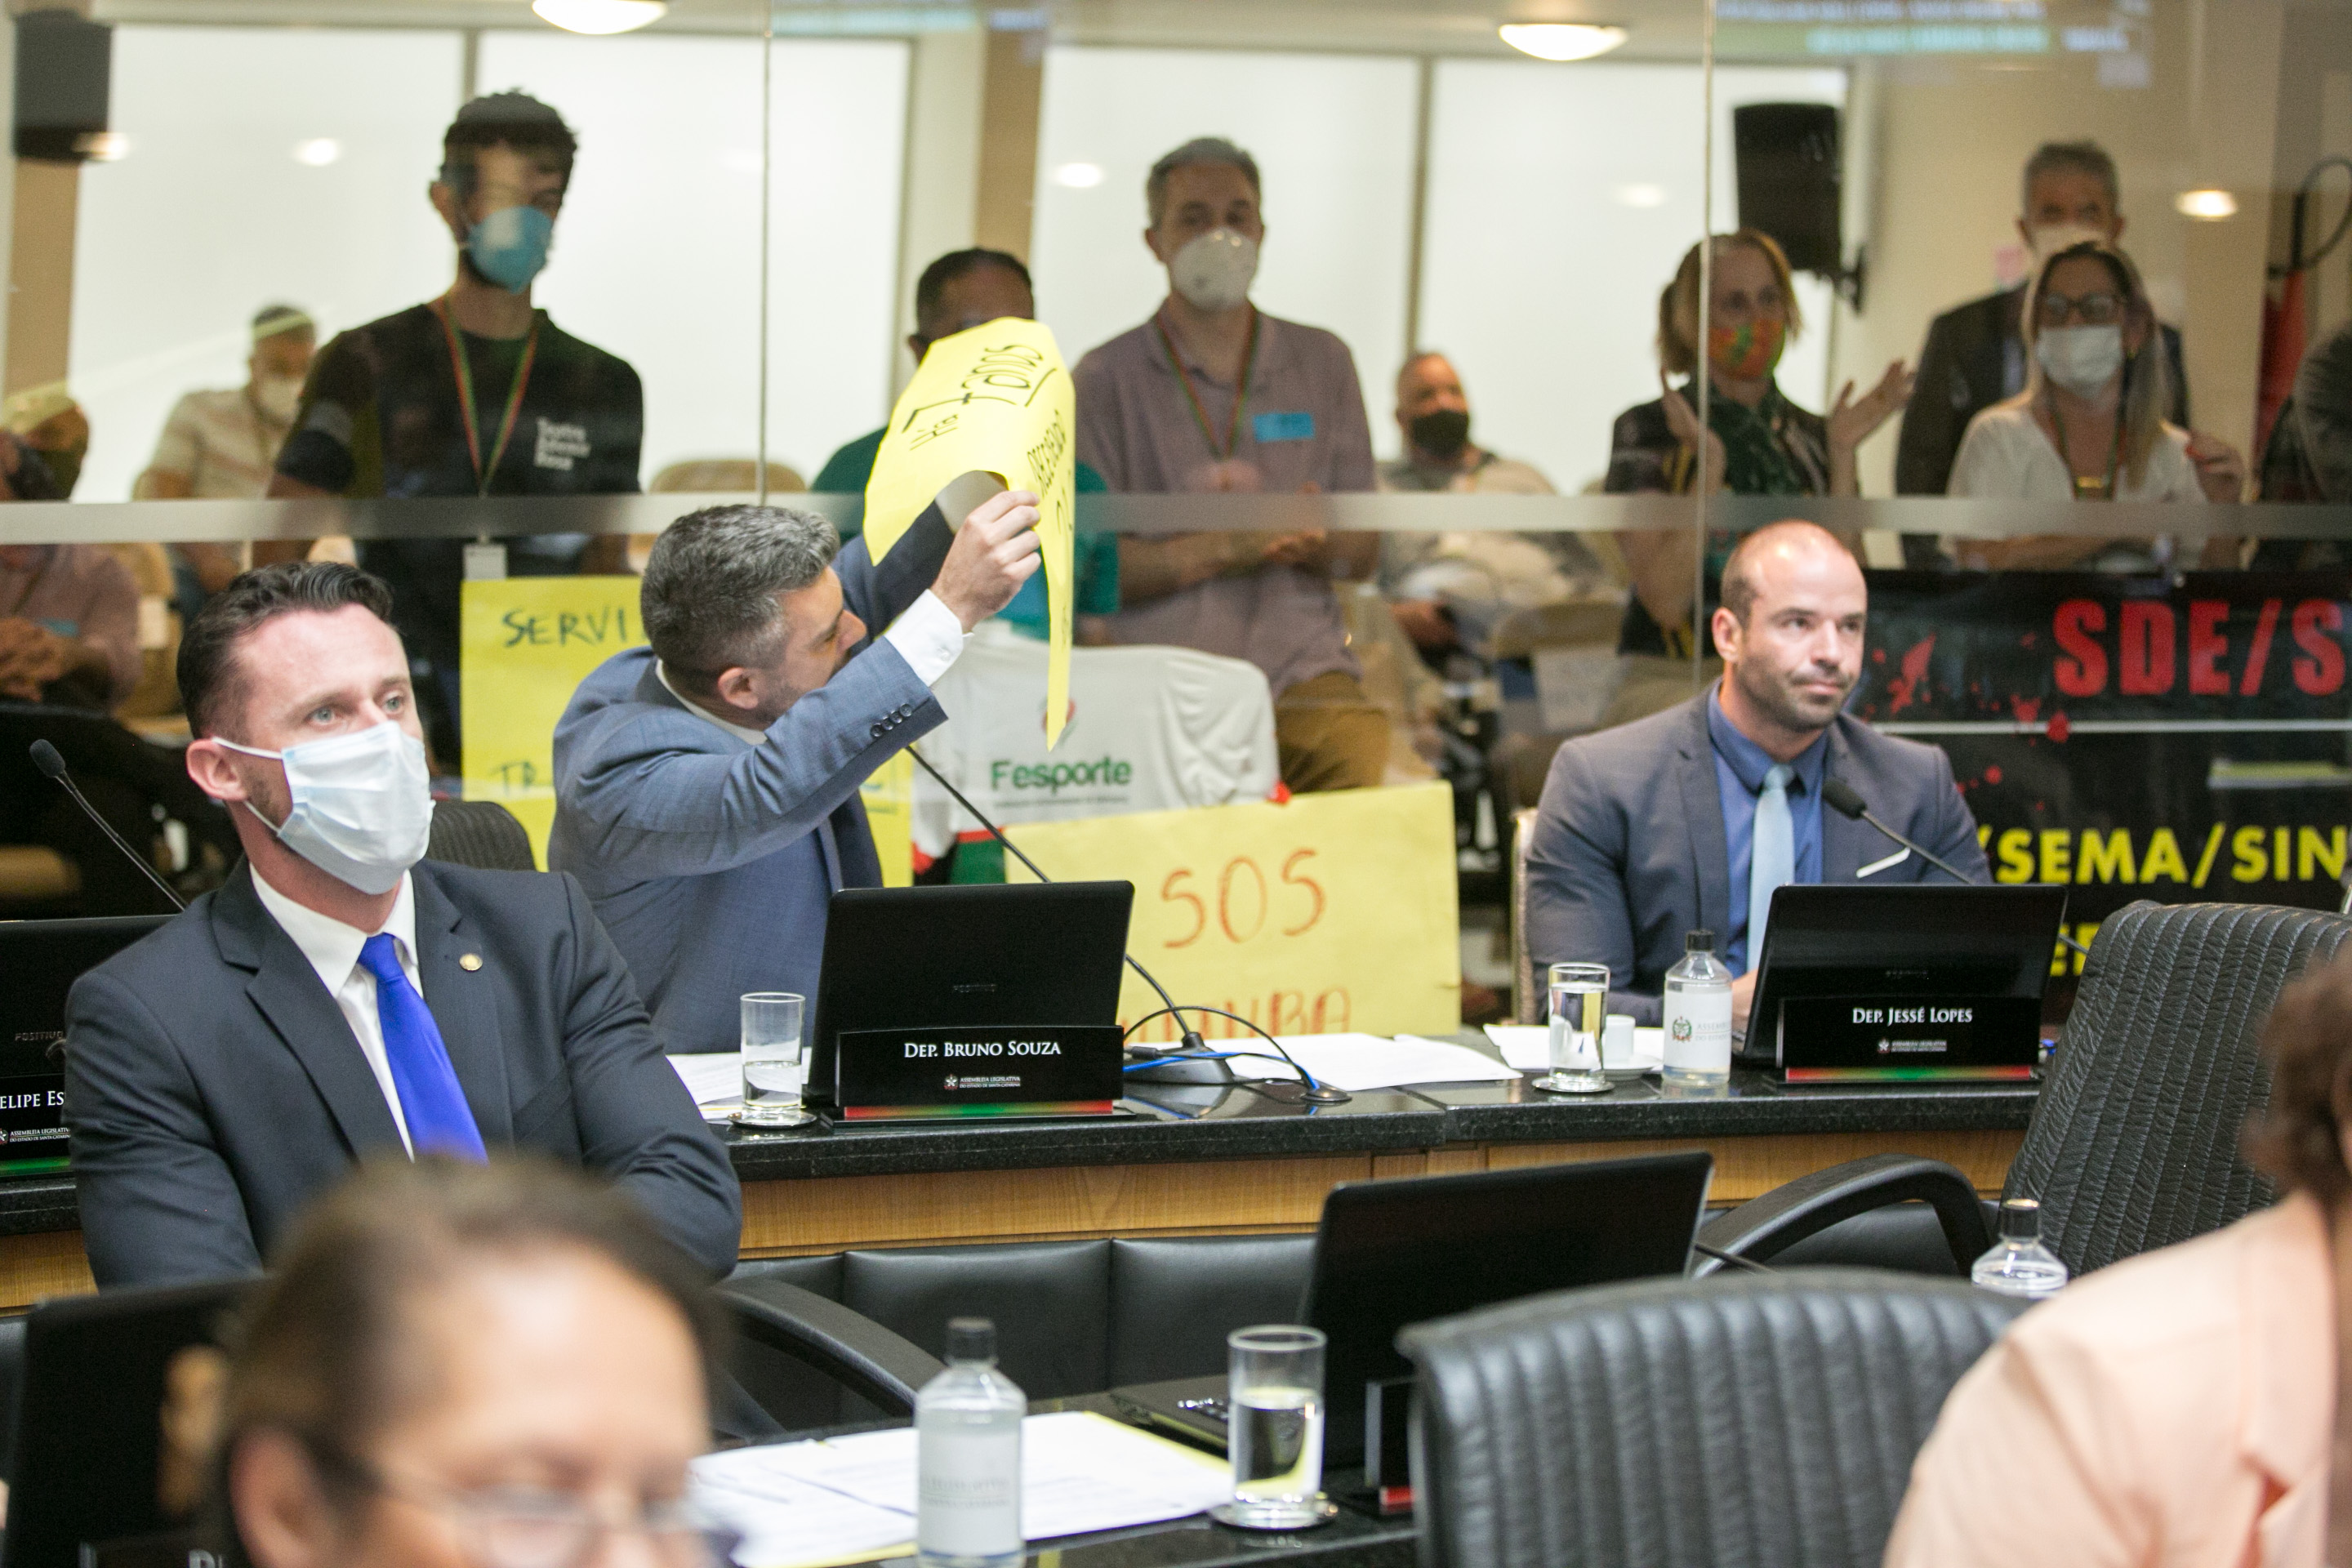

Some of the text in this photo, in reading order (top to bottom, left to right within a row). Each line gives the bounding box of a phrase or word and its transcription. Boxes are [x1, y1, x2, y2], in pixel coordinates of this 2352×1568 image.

[502, 604, 649, 646] SERVI
[2052, 598, 2346, 697] SDE/S
[990, 756, 1133, 796] Fesporte
[1159, 846, 1327, 950] SOS
[1887, 1005, 1925, 1027] JESSÉ
[1930, 1006, 1973, 1023] LOPES
[943, 1041, 1003, 1057] BRUNO
[1007, 1040, 1062, 1056] SOUZA
[47, 1090, 65, 1106] ES
